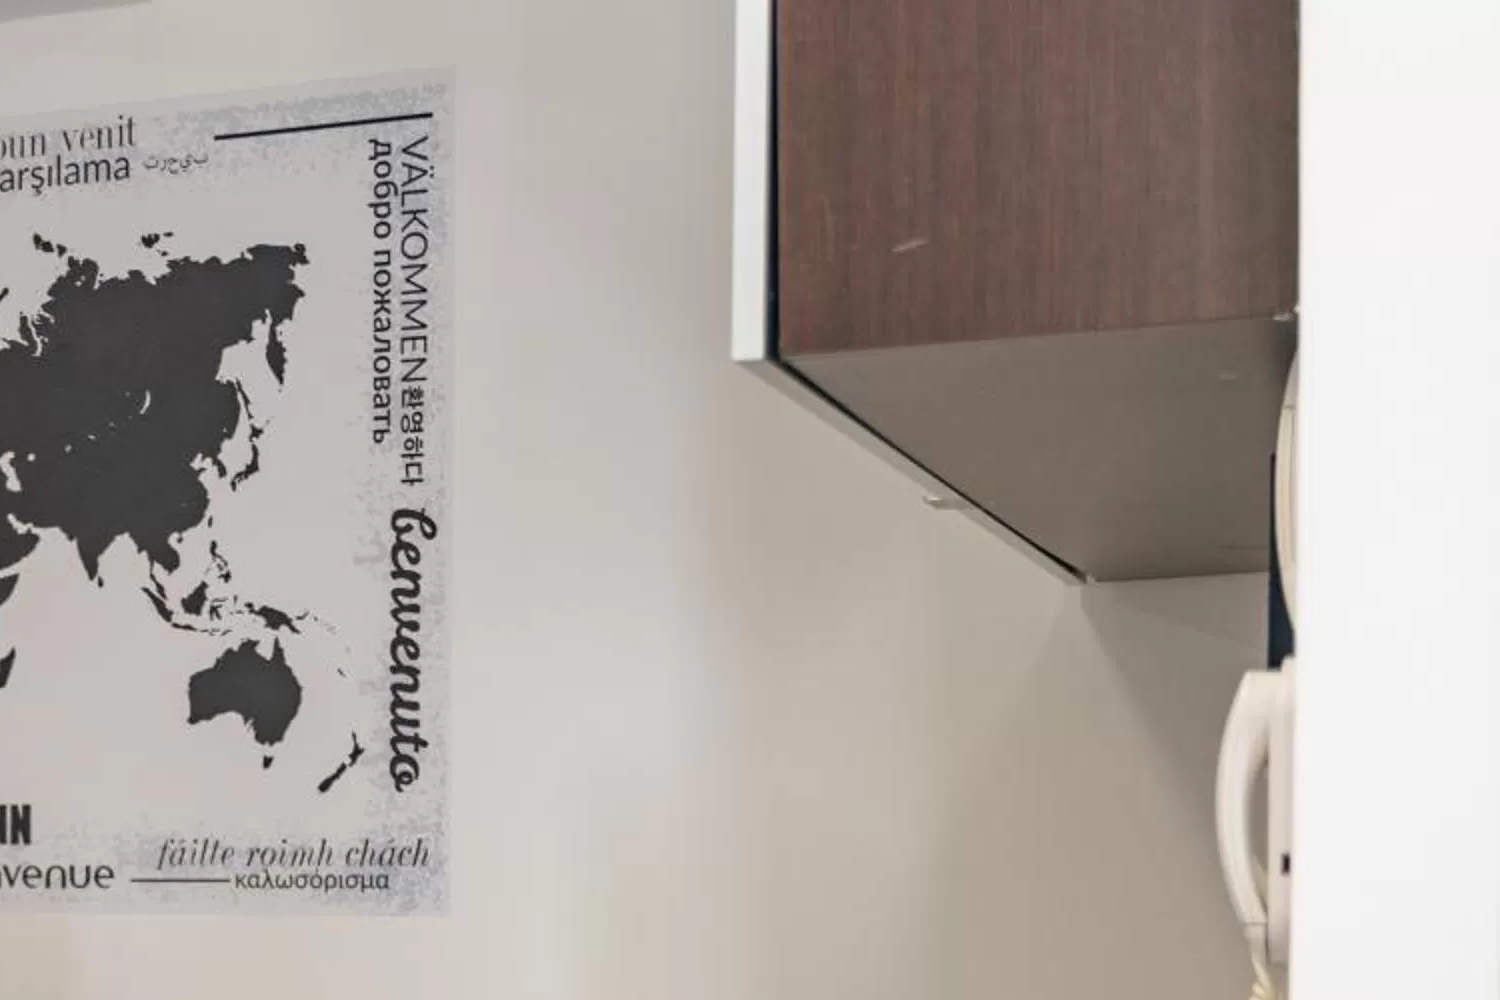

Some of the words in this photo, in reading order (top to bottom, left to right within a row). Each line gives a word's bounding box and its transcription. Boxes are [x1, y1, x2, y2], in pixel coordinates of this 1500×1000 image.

[62, 114, 136, 151] venit
[367, 139, 399, 239] добро
[400, 135, 435, 383] VÄLKOMMEN
[373, 249, 392, 444] пожаловать
[400, 386, 425, 486] 환영하다
[389, 507, 438, 793] benvenuto
[235, 867, 390, 892] καλωσόρισμα
